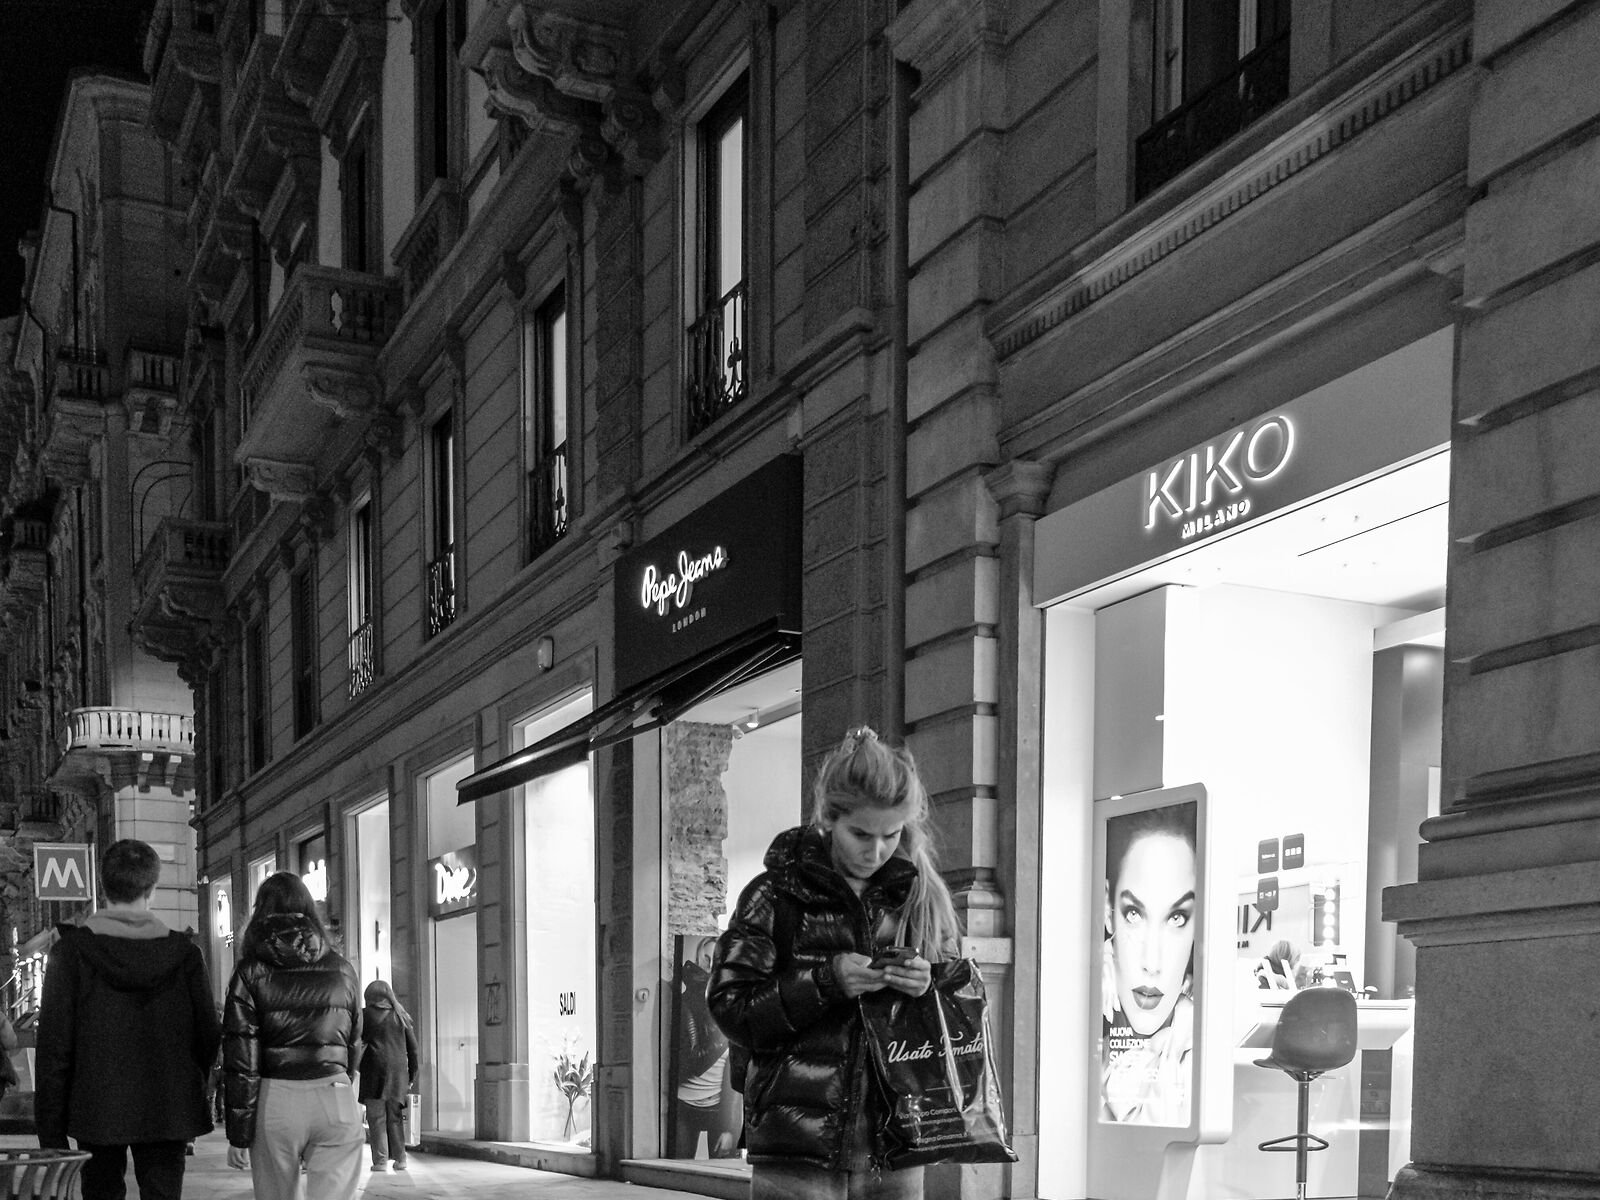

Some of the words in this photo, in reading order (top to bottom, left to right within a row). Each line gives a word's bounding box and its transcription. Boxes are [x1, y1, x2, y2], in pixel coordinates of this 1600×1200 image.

[1143, 415, 1295, 529] KIKO
[1181, 498, 1251, 539] MILANO
[641, 564, 678, 616] Pepe
[676, 545, 726, 608] Jeans
[672, 607, 707, 633] LONDON
[41, 856, 85, 889] M
[559, 991, 577, 1017] SALDI
[1109, 1026, 1134, 1038] NUOVA
[1109, 1038, 1152, 1050] COLLEZIONE
[887, 1039, 934, 1063] Usato
